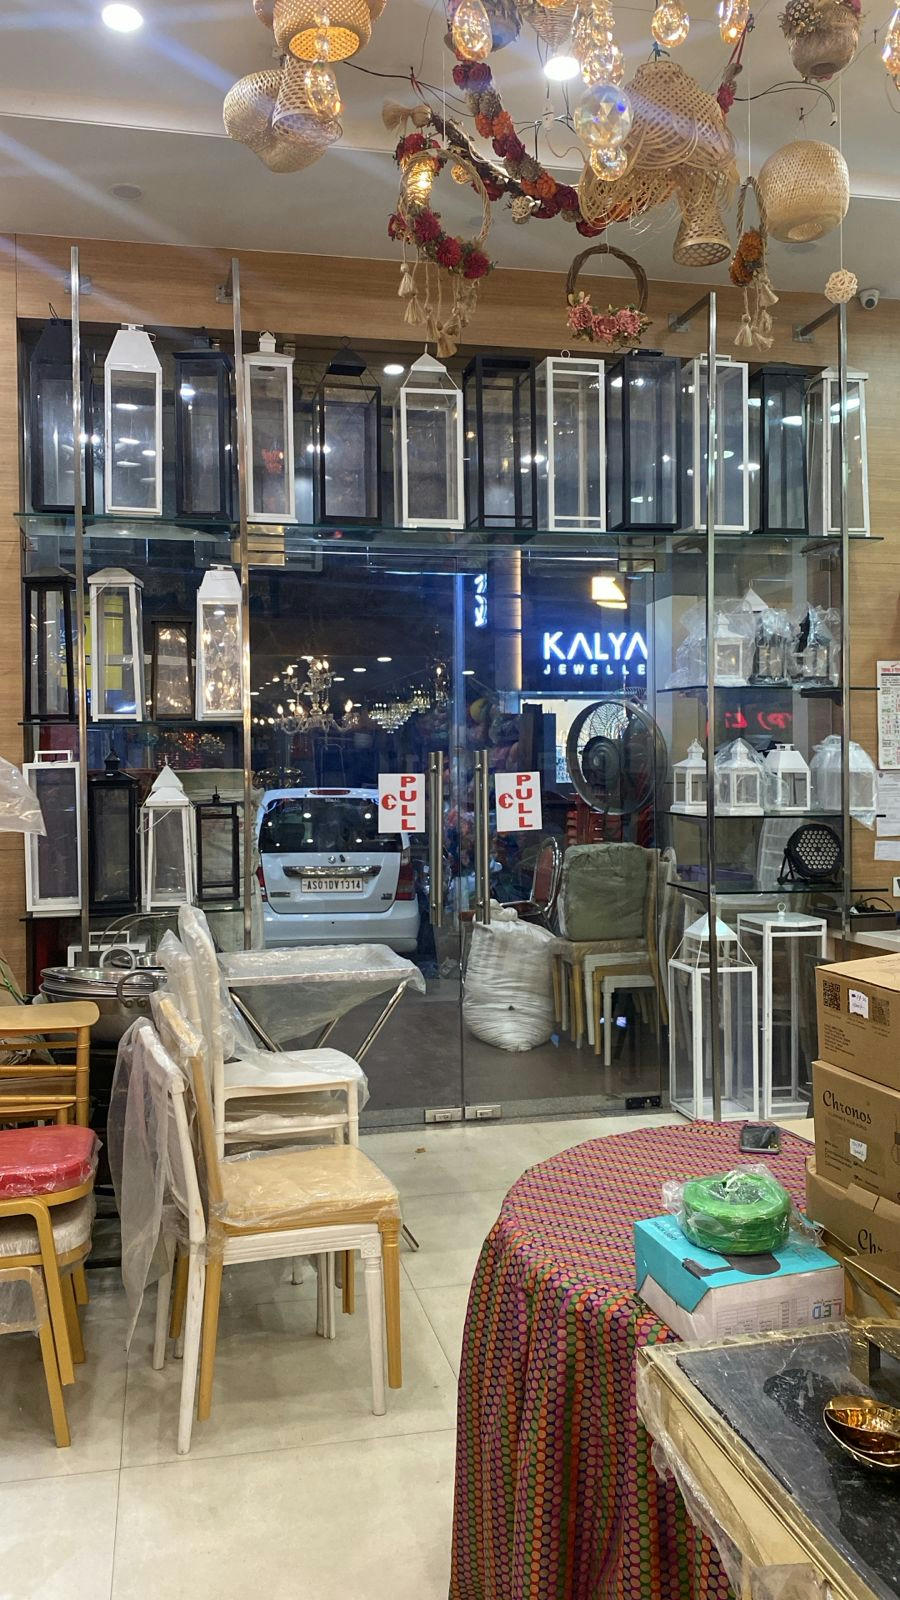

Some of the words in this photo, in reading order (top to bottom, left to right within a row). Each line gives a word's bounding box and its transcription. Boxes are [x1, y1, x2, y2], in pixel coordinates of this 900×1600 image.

[399, 776, 417, 831] PULL
[515, 774, 533, 828] PULL
[822, 1090, 872, 1125] Chronos
